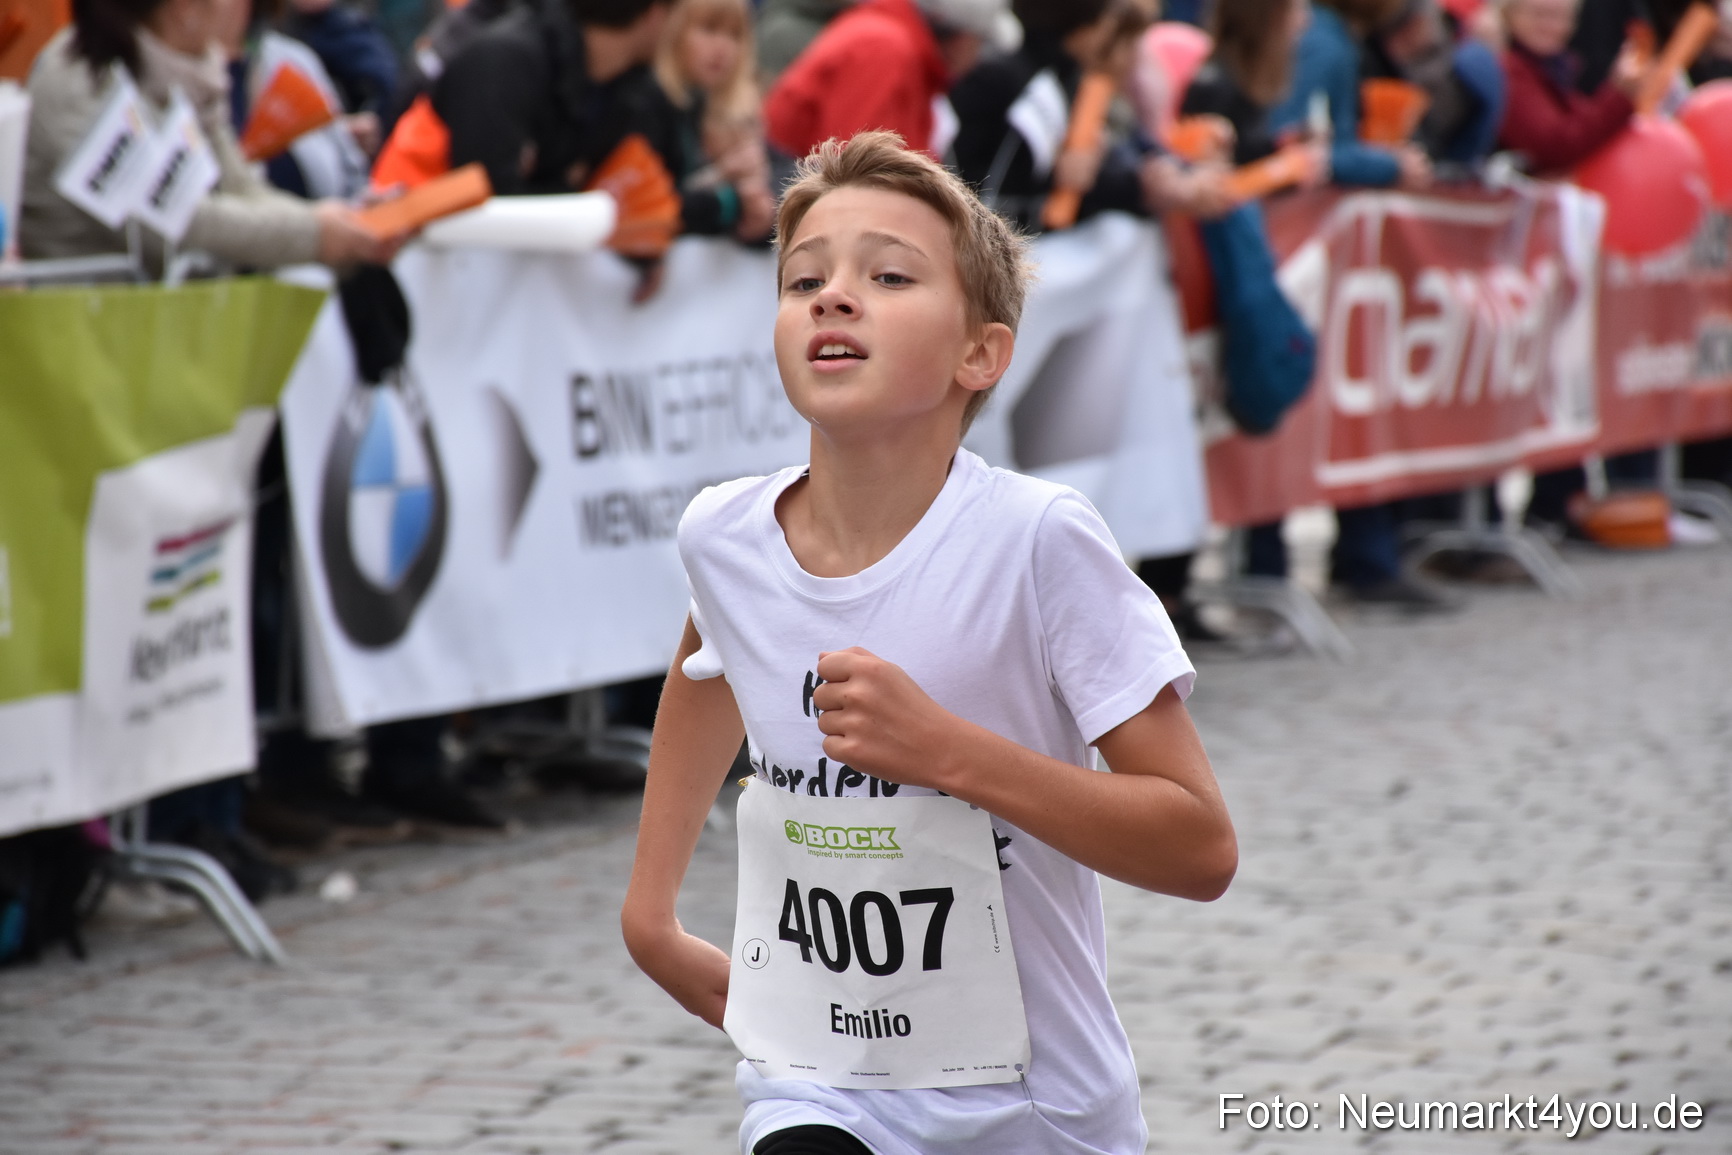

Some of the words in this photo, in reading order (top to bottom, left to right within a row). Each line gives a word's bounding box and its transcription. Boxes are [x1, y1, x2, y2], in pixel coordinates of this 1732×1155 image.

[804, 824, 900, 850] BOCK
[807, 848, 832, 858] inspired
[834, 851, 843, 859] by
[869, 851, 904, 860] concepts
[779, 878, 954, 976] 4007
[751, 946, 761, 962] J
[830, 1003, 911, 1039] Emilio
